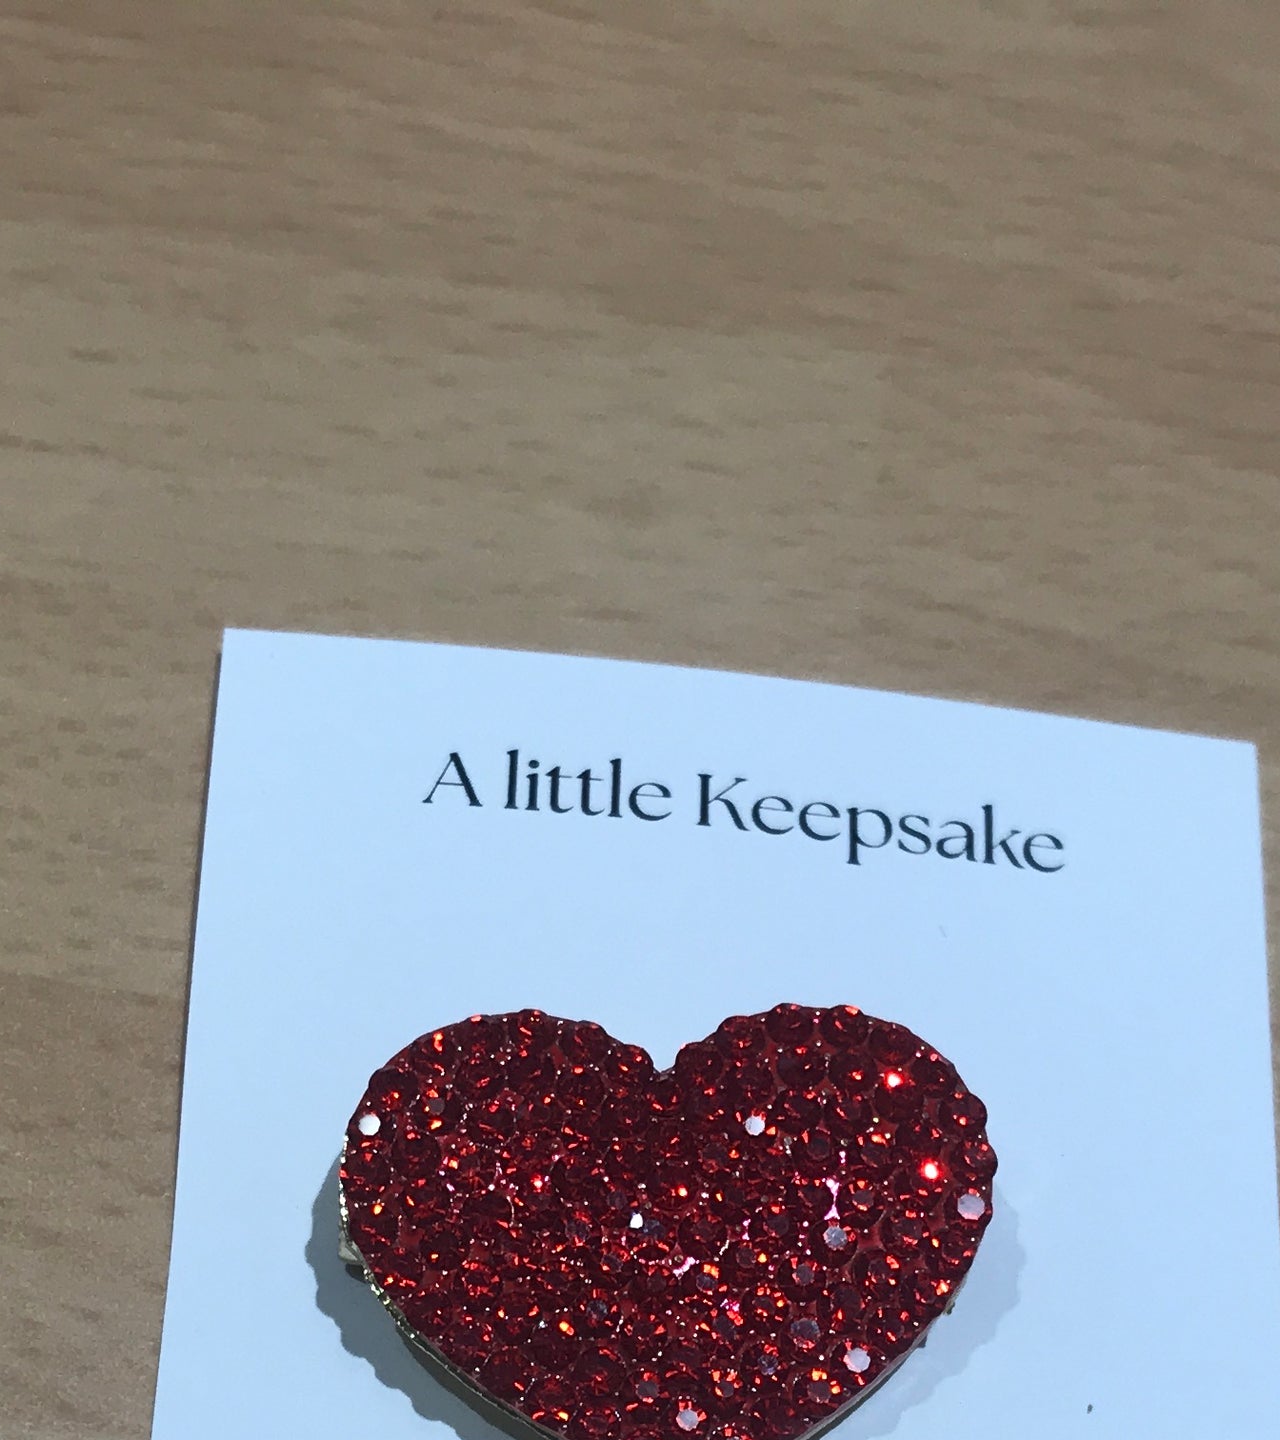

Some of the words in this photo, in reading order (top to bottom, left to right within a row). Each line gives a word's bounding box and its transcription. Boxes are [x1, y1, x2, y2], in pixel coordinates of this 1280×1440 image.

[421, 751, 484, 808] A
[503, 748, 673, 822] little
[695, 772, 1065, 874] Keepsake
